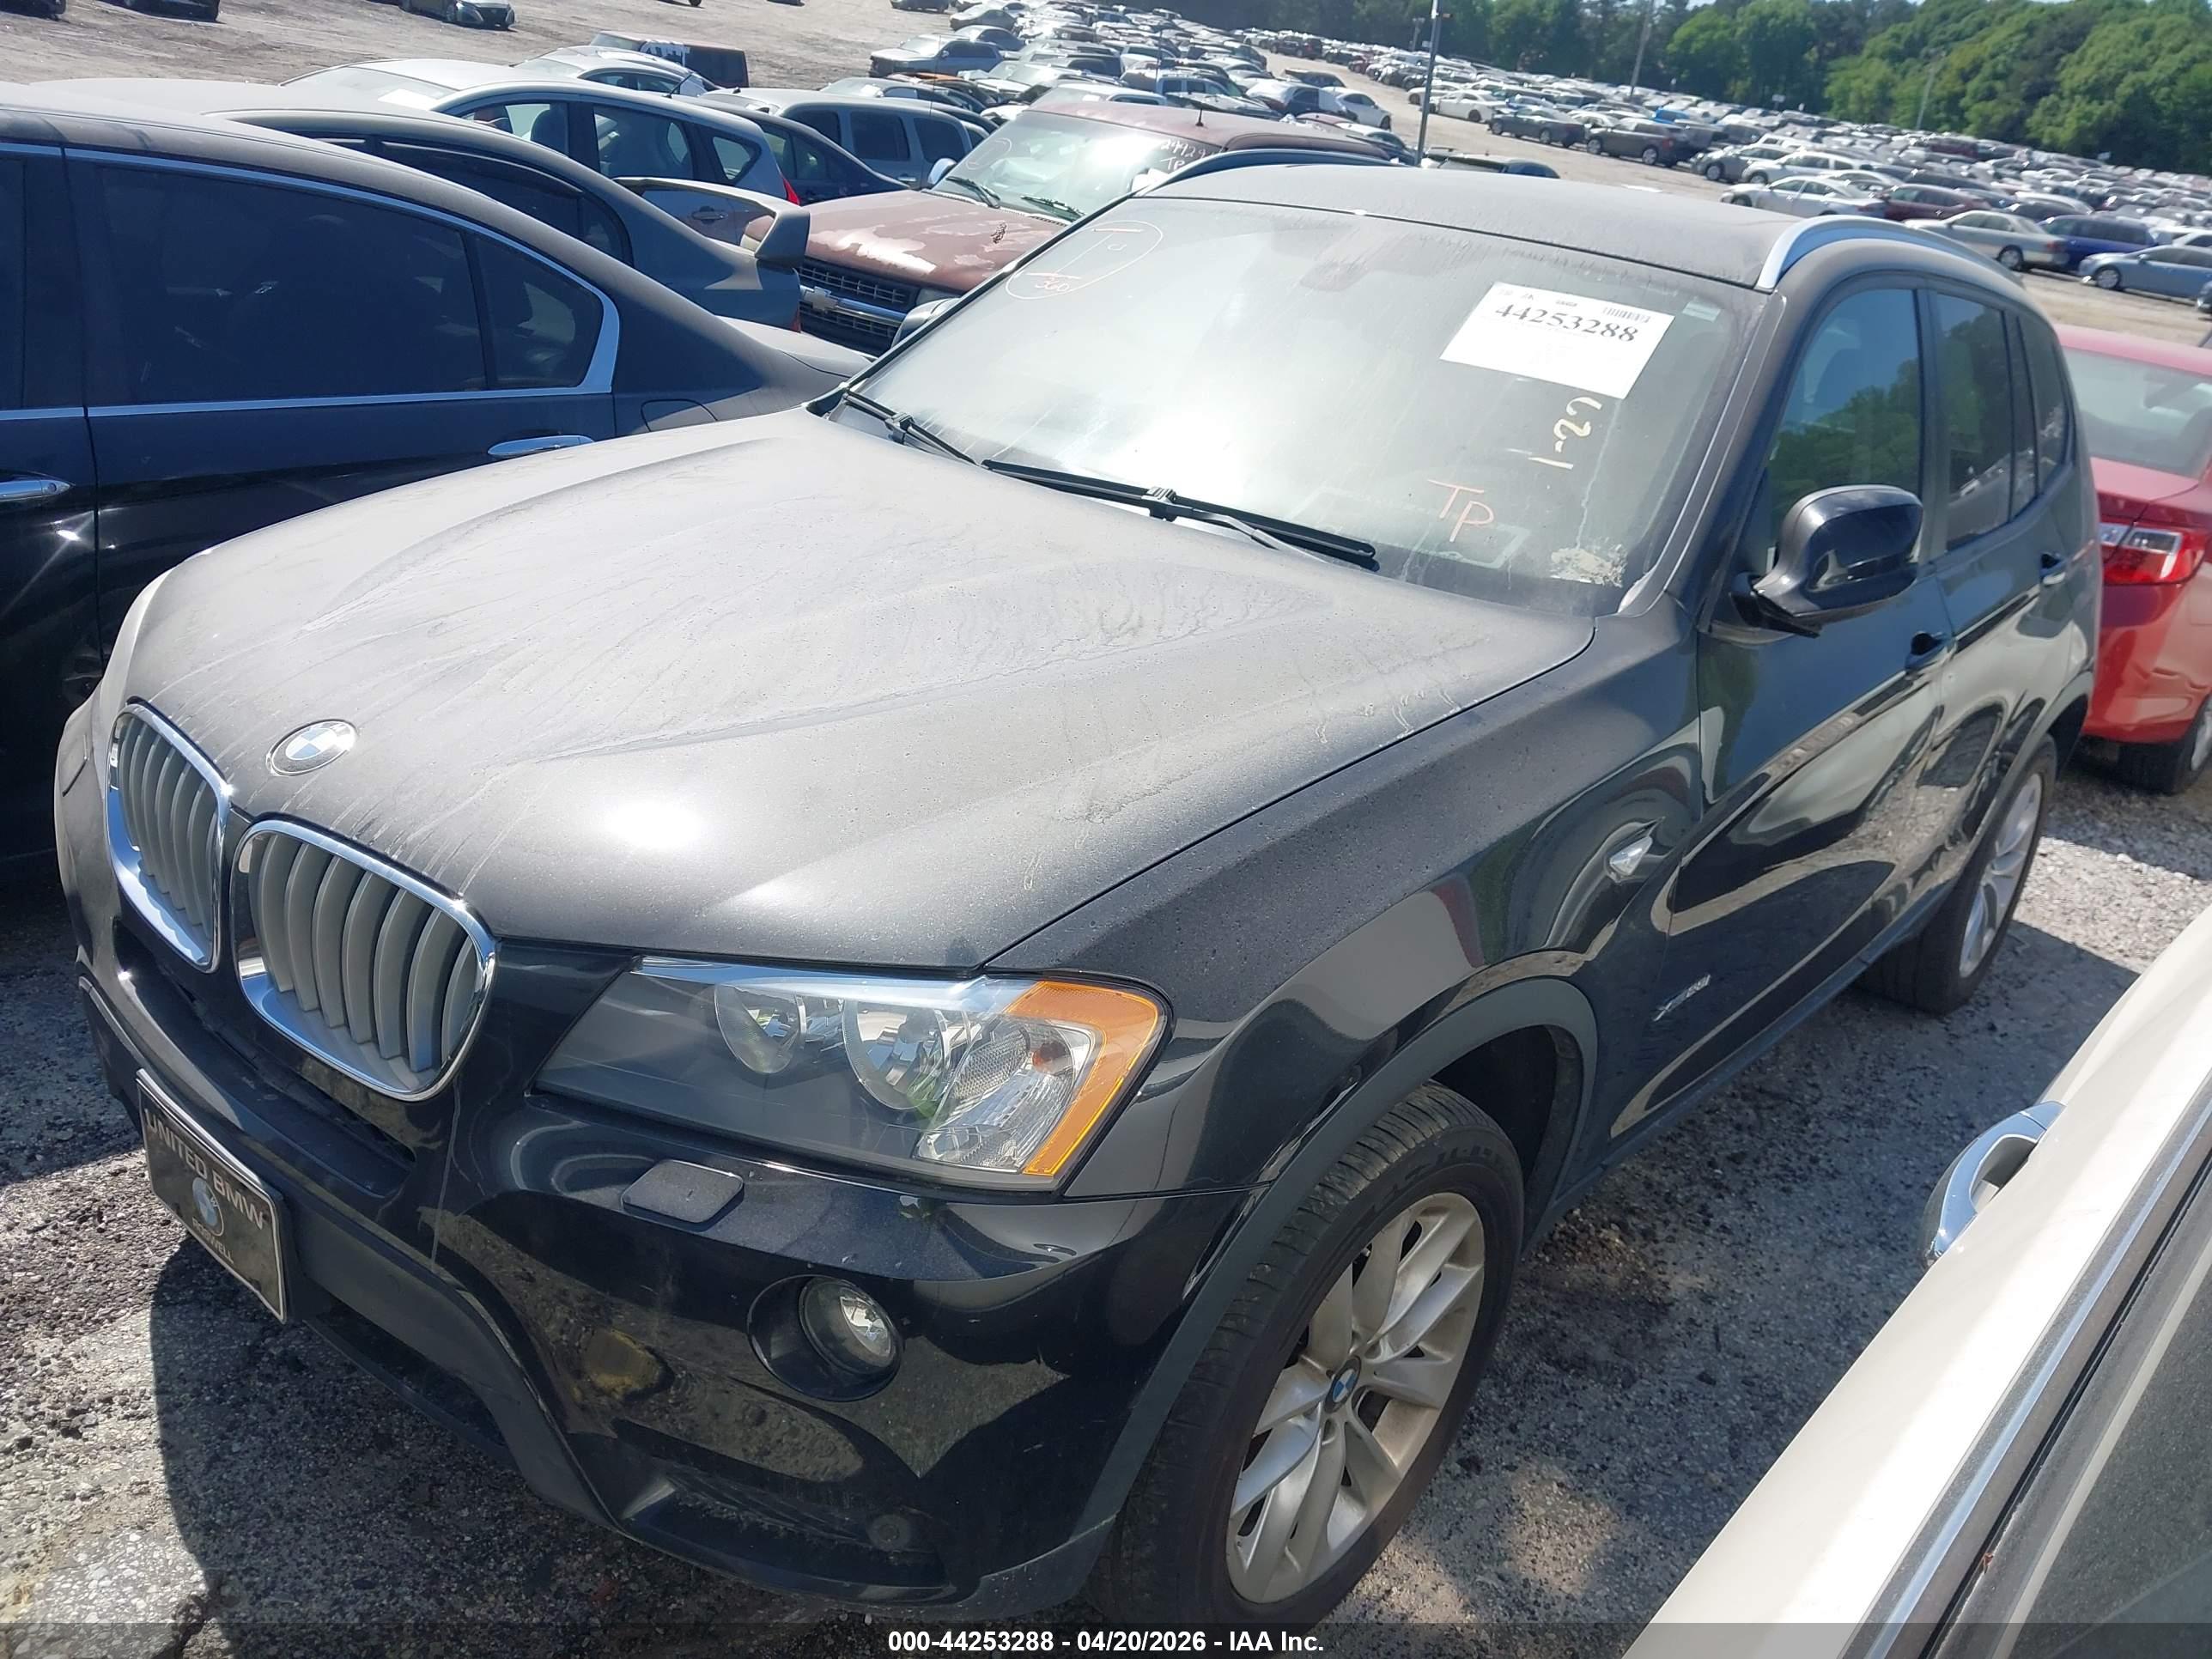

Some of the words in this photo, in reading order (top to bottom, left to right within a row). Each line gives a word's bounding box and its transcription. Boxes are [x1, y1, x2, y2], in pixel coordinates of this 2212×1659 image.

[1494, 303, 1639, 343] 44253288
[1427, 479, 1495, 543] TP
[143, 1108, 209, 1181] UNITED
[211, 1169, 264, 1231] BMW
